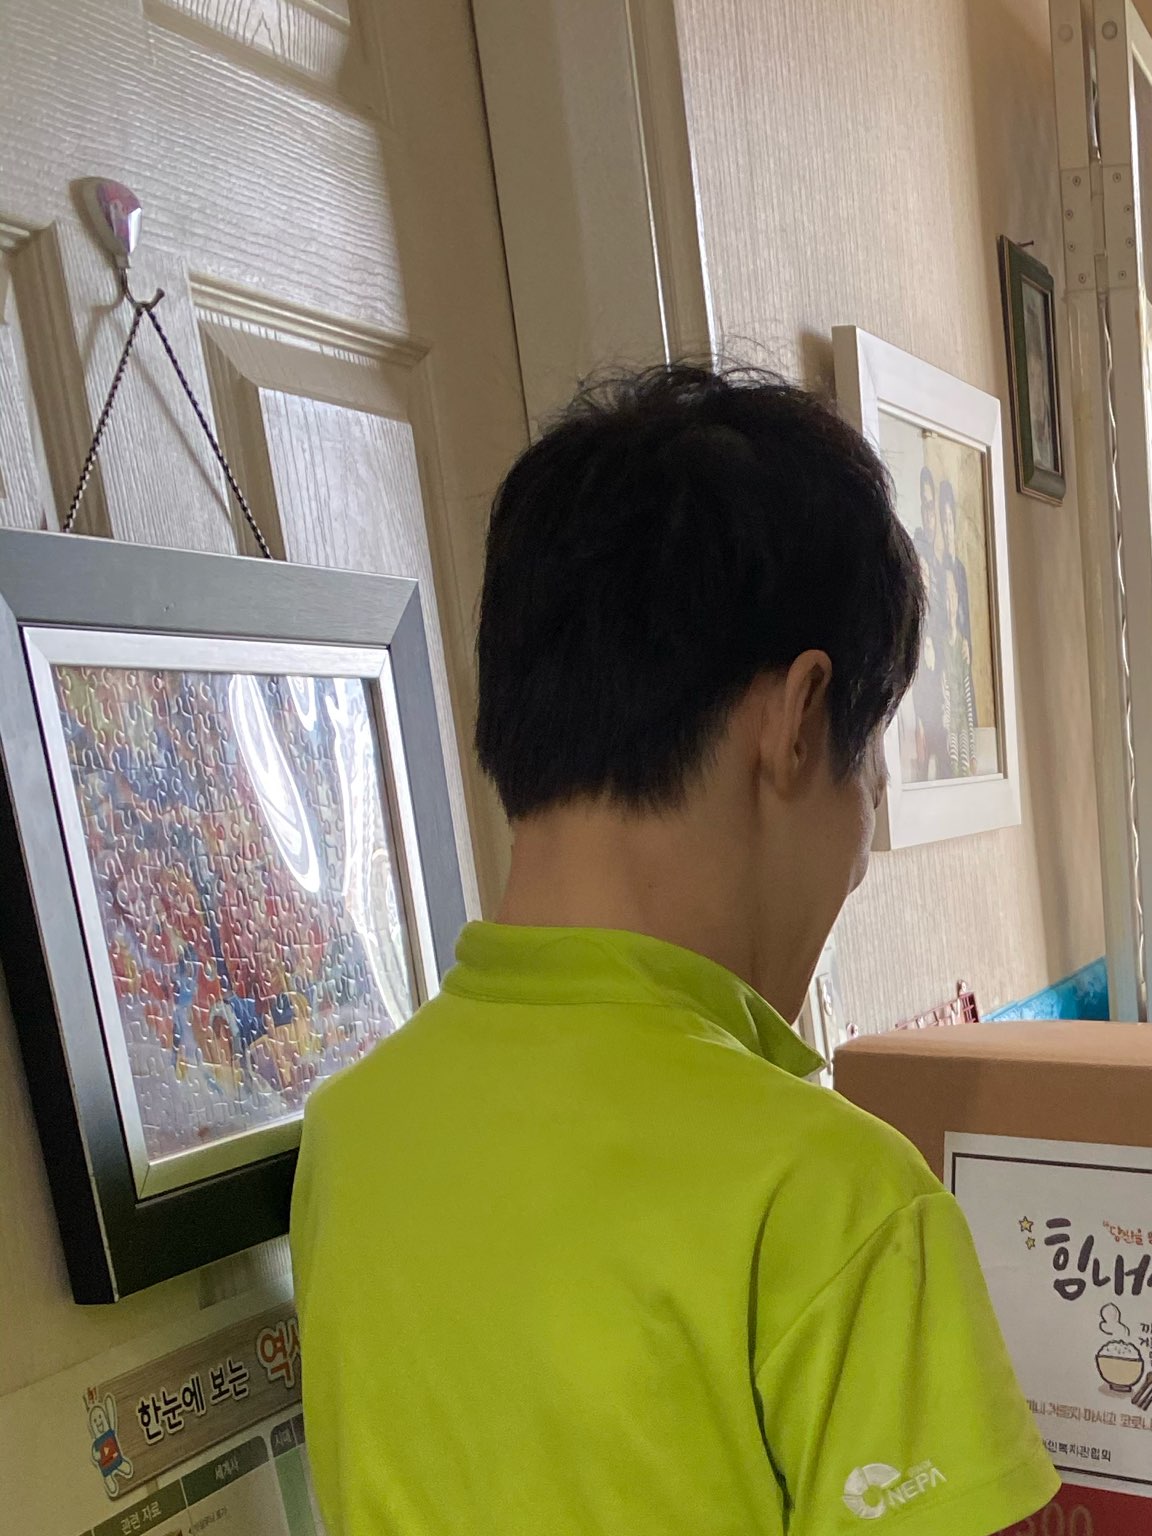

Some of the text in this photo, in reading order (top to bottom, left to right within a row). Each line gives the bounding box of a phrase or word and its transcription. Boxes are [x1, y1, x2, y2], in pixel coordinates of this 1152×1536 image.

[137, 1375, 205, 1441] 한눈에
[210, 1360, 249, 1402] 보는
[214, 1458, 240, 1481] 세계사
[886, 1467, 948, 1507] NEPA
[119, 1501, 162, 1536] 관련 자료
